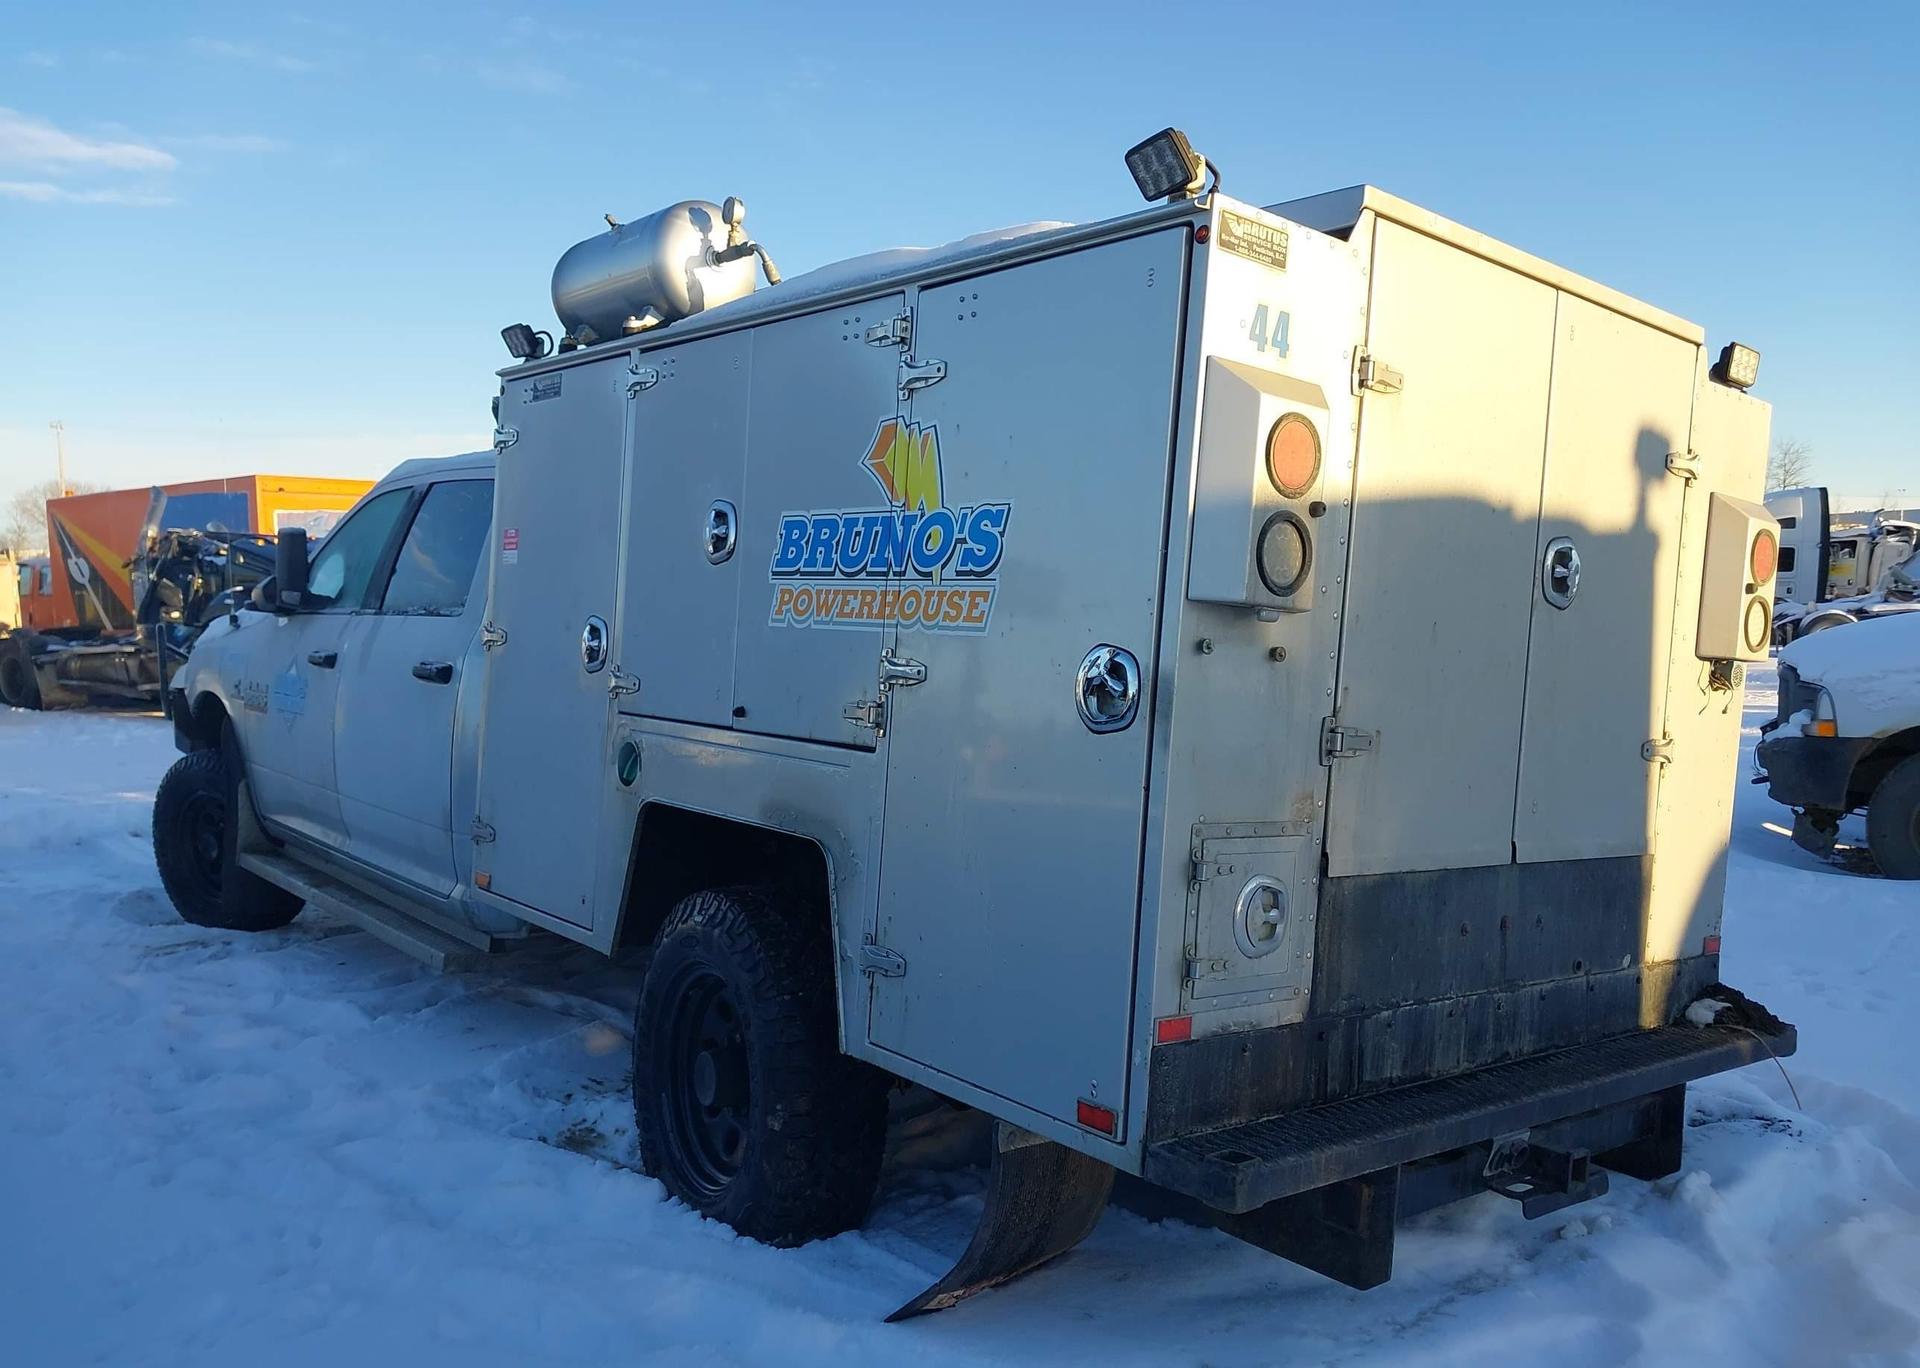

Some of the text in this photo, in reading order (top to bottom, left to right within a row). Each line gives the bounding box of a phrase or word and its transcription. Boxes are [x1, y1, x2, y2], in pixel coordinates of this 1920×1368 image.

[1243, 219, 1288, 248] BRUTUS
[1243, 234, 1272, 248] SERVICE
[1249, 303, 1290, 359] 44
[771, 504, 1011, 577] BRUNO'S
[771, 585, 994, 630] POWERHOUSE
